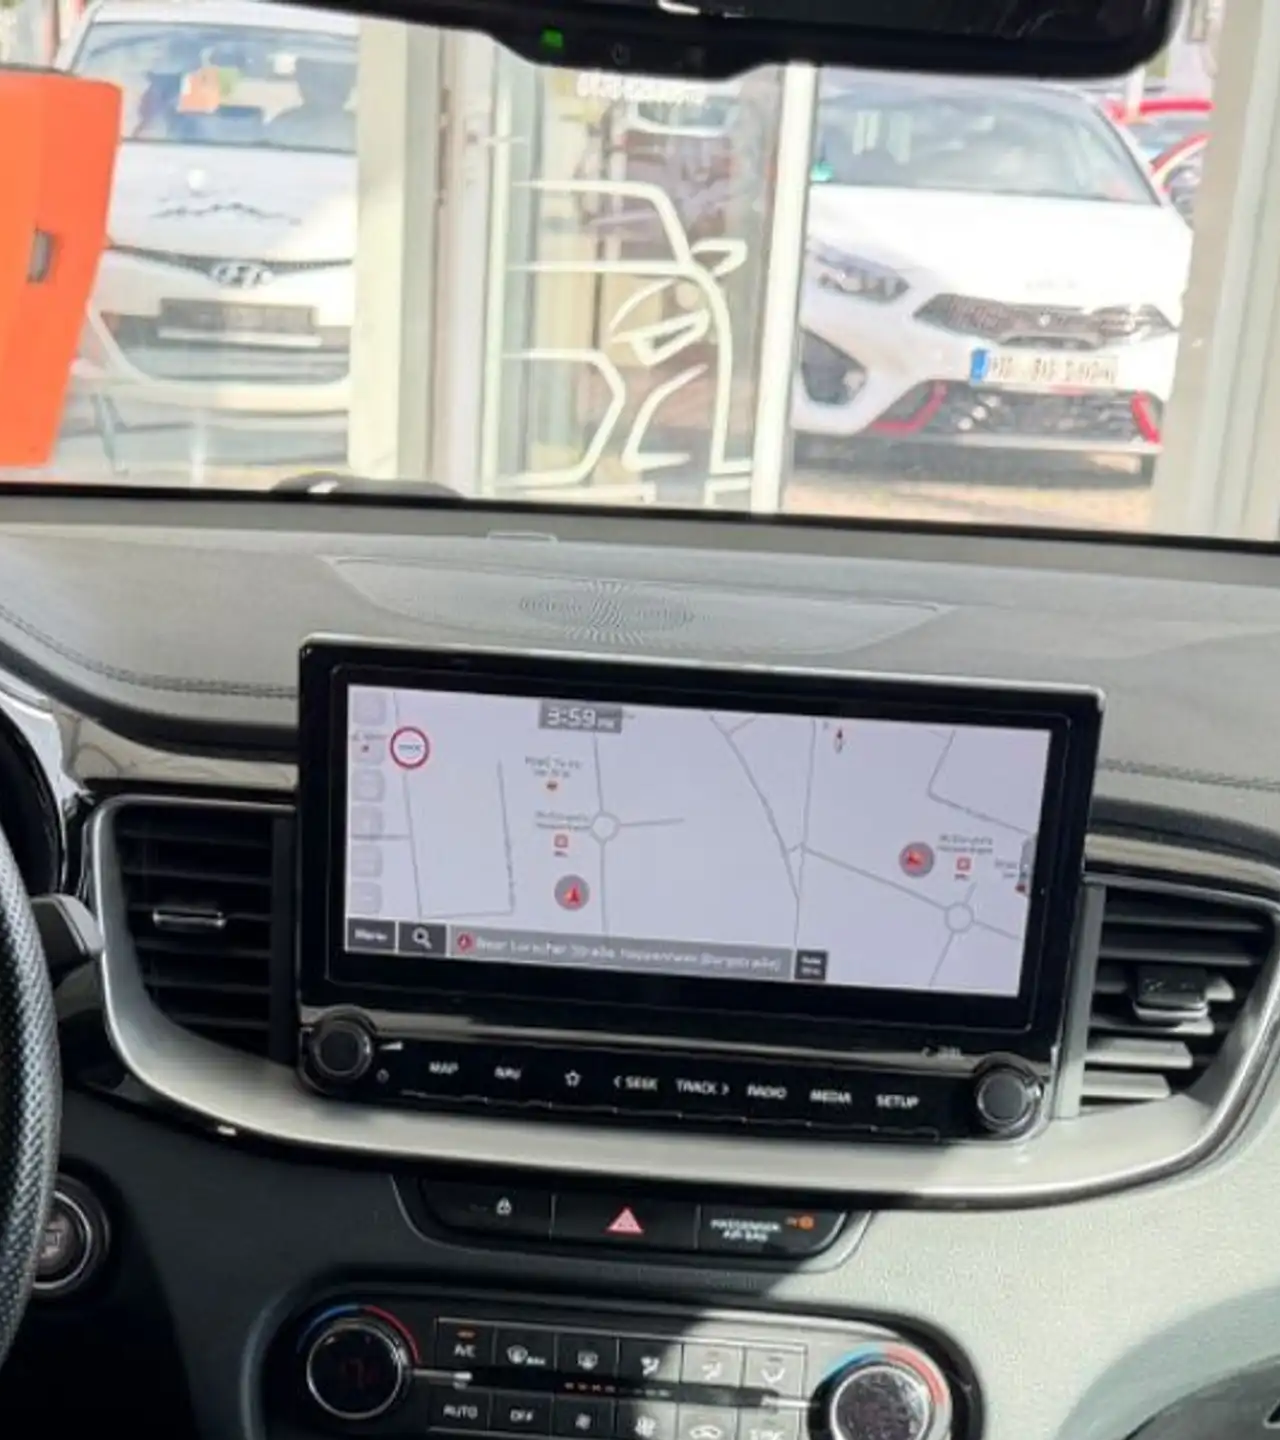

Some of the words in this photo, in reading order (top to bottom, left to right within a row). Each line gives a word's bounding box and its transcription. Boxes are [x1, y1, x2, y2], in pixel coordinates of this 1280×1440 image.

[547, 706, 596, 727] 3:59
[428, 1061, 459, 1075] MAP
[624, 1075, 658, 1092] SEEK
[675, 1078, 718, 1095] TRACK
[746, 1084, 787, 1100] RADIO
[809, 1088, 852, 1104] MEDIA
[875, 1093, 919, 1109] SETUP
[442, 1404, 478, 1419] AUTO
[509, 1408, 534, 1422] OFF
